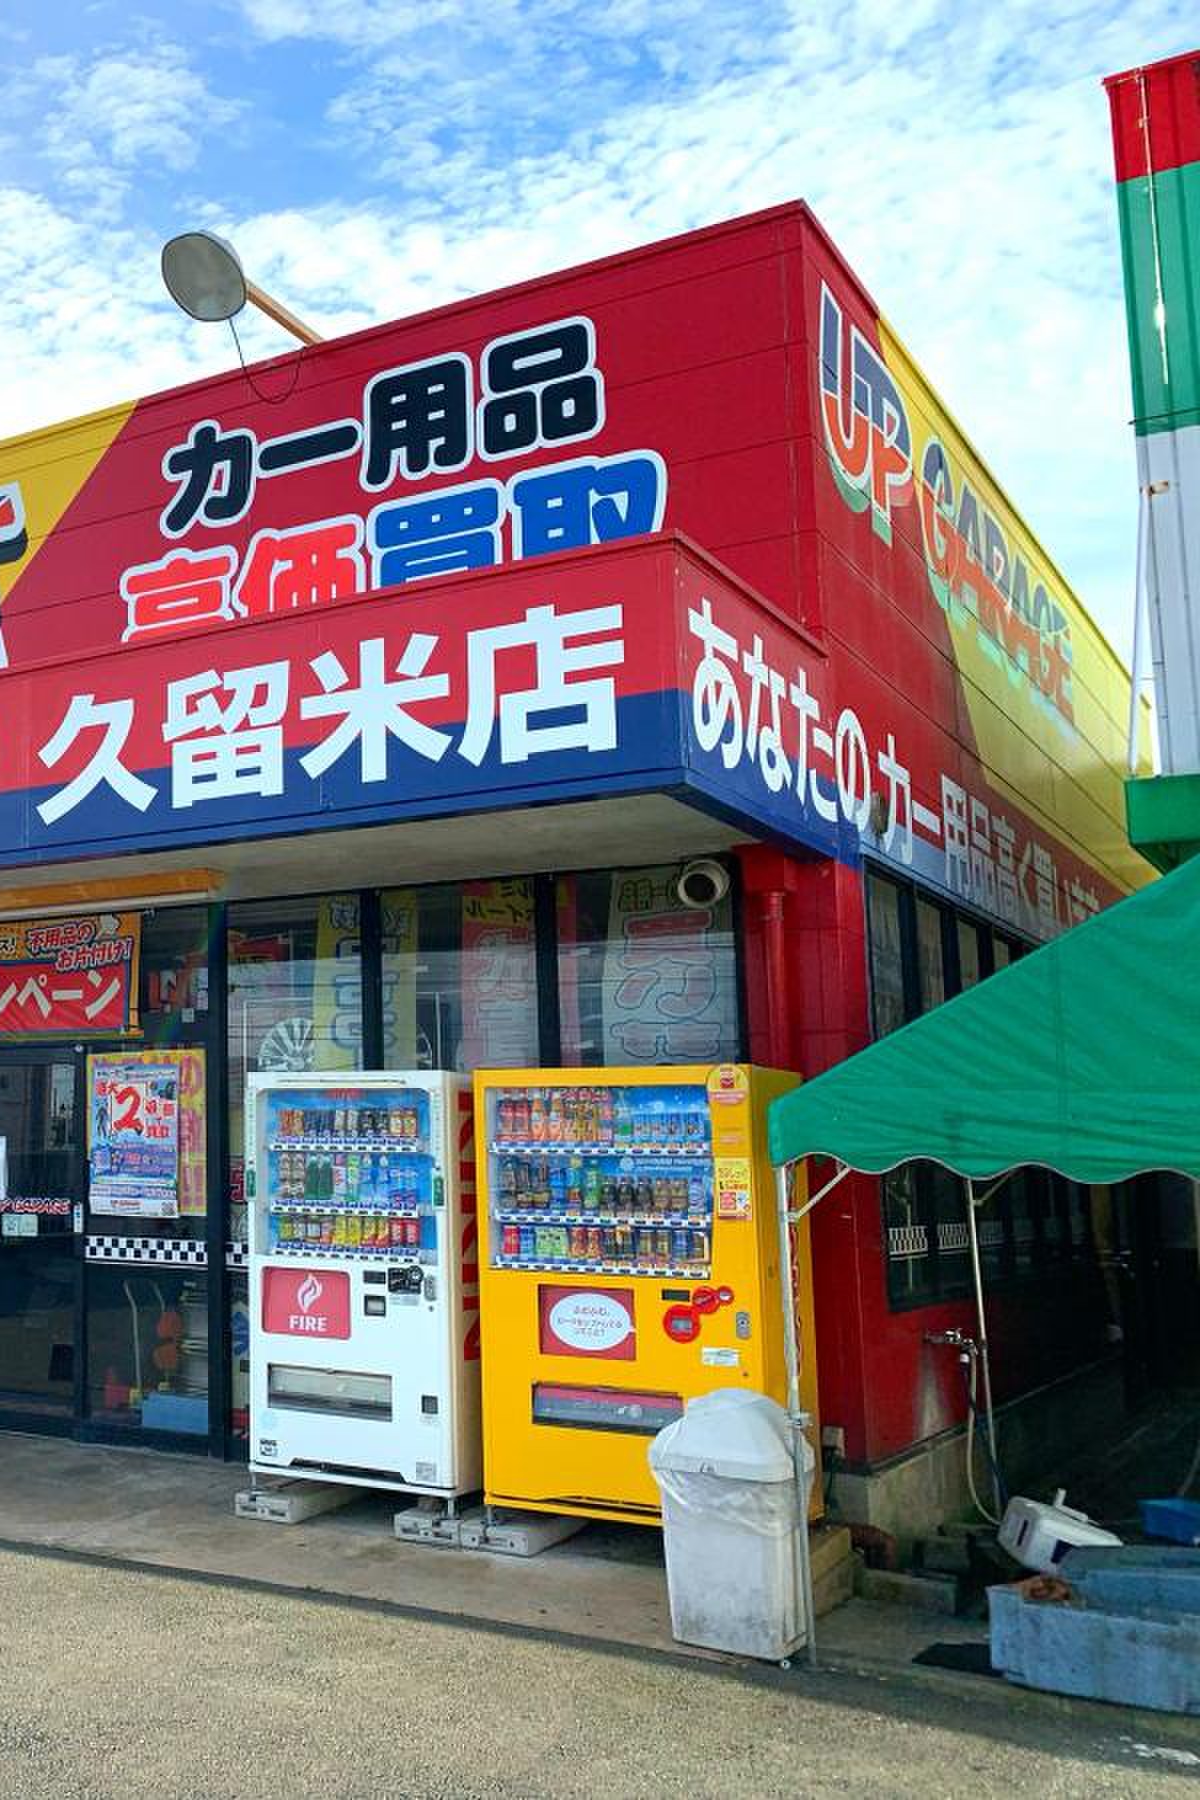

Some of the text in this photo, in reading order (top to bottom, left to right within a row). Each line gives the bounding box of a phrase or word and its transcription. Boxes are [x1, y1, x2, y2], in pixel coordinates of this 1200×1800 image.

[159, 314, 605, 540] カー用品
[819, 278, 1074, 730] UP GARAGE
[120, 448, 668, 643] 高価買取
[35, 603, 626, 827] 久留米店
[288, 1314, 328, 1333] FIRE
